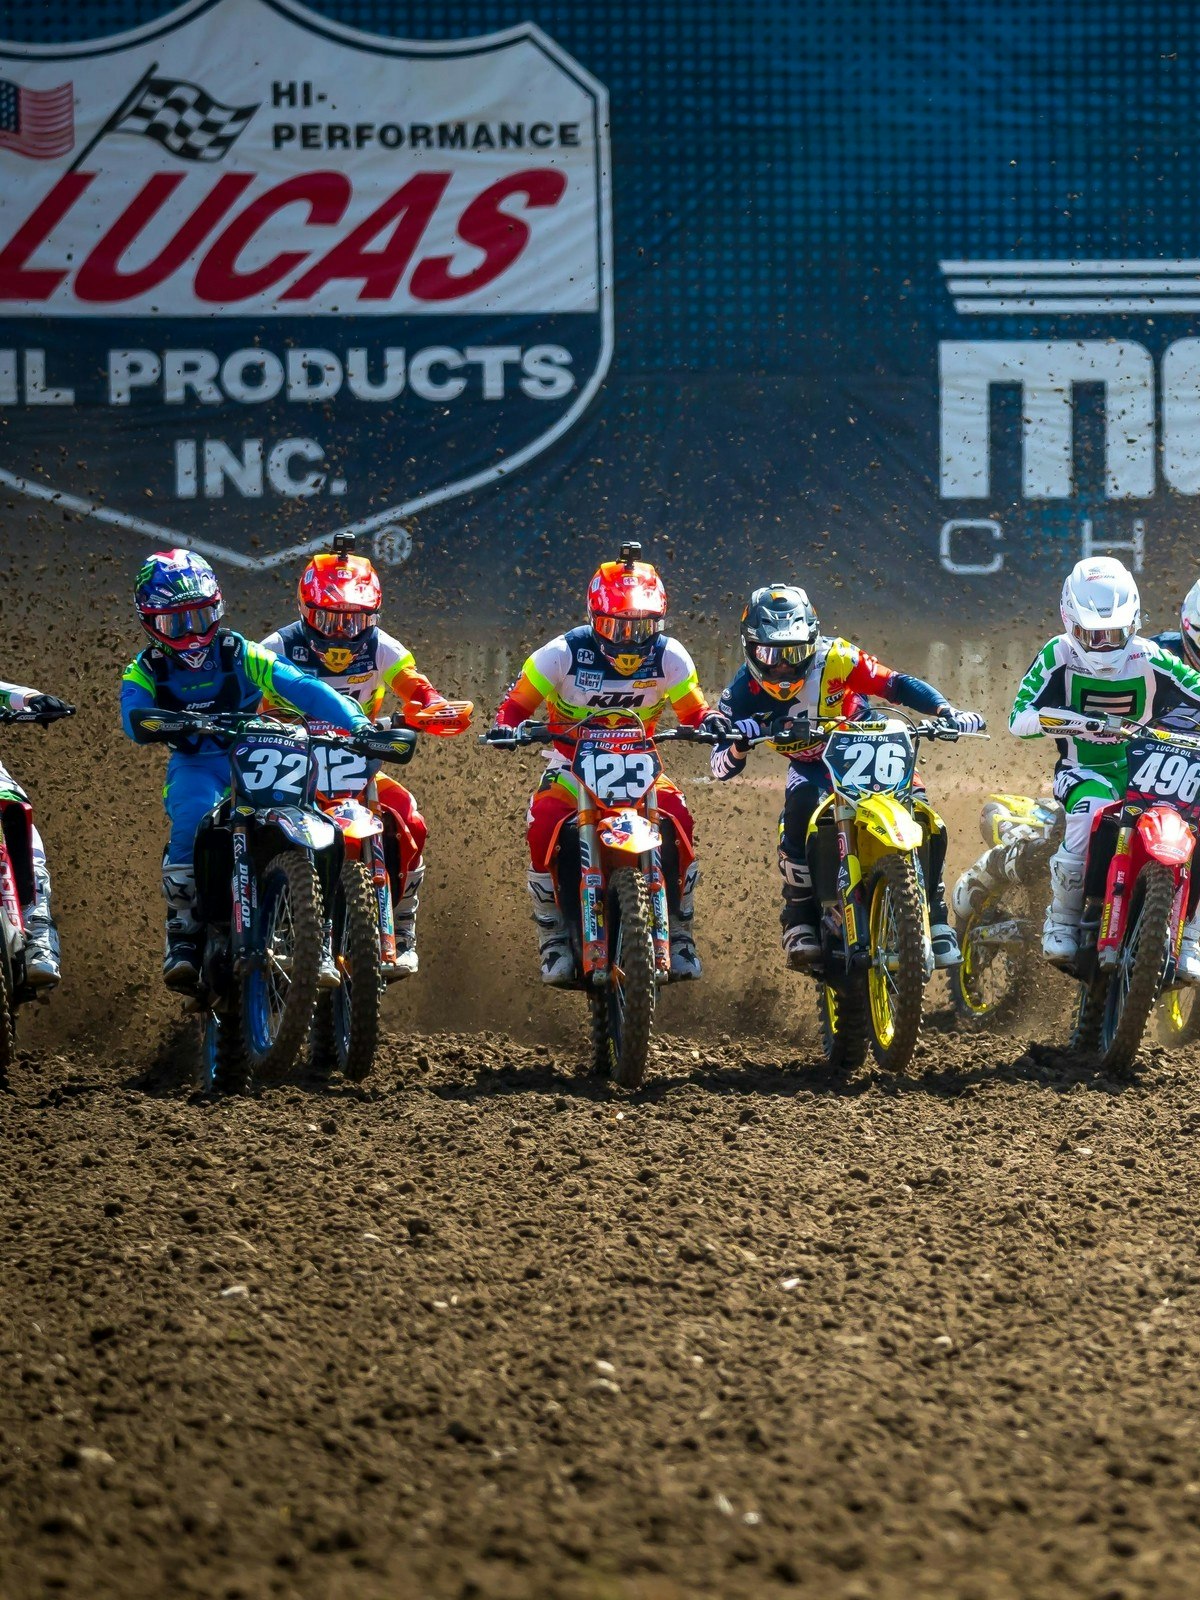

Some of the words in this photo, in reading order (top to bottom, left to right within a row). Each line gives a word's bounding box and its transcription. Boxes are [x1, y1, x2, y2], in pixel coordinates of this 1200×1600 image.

[272, 81, 327, 107] HI-
[272, 122, 580, 150] PERFORMANCE
[0, 169, 567, 301] LUCAS
[107, 345, 577, 406] PRODUCTS
[173, 438, 347, 498] INC.
[587, 692, 645, 708] KTM
[258, 736, 283, 747] LUCAS
[284, 738, 295, 748] OIL
[1155, 745, 1180, 754] LUCAS
[1180, 749, 1191, 757] OIL
[243, 748, 308, 794] 32
[315, 745, 368, 791] 12
[580, 753, 655, 799] 123
[842, 743, 906, 787] 26
